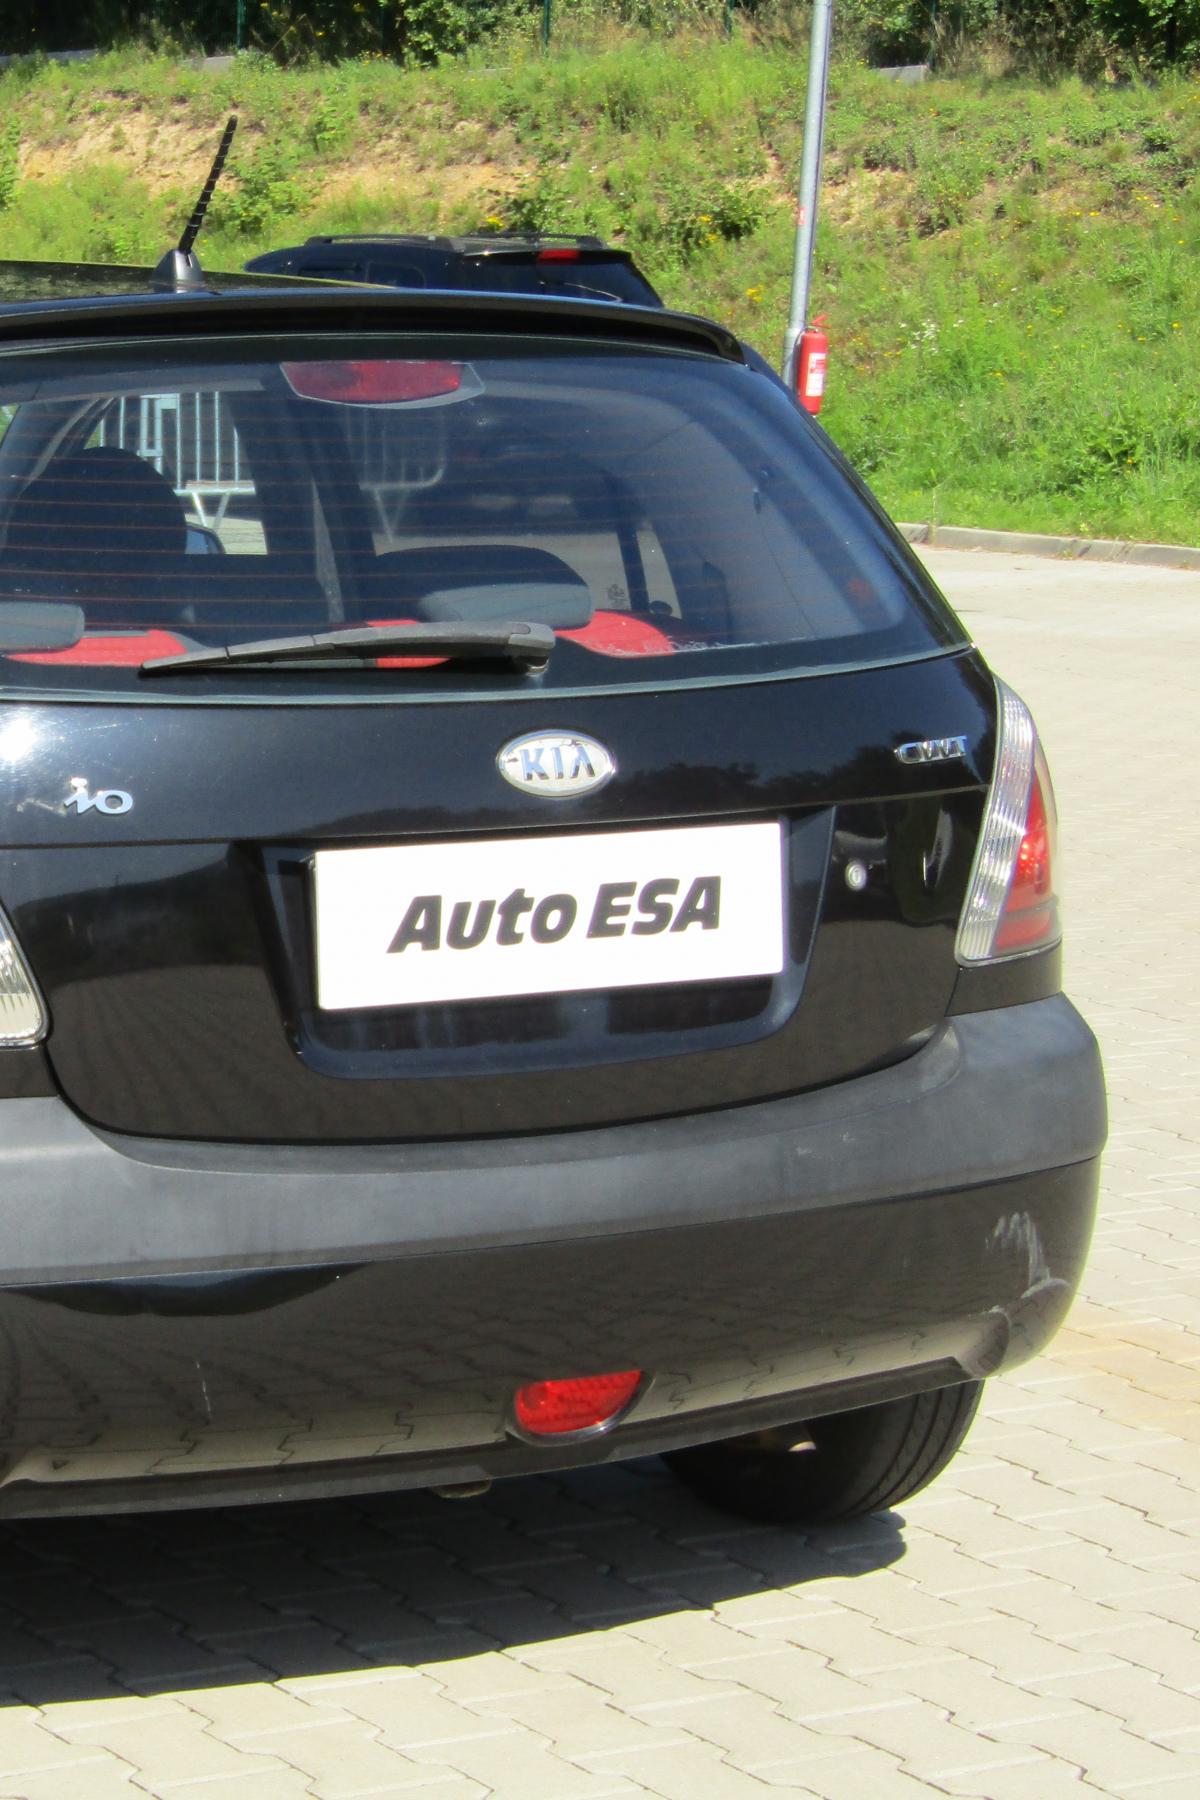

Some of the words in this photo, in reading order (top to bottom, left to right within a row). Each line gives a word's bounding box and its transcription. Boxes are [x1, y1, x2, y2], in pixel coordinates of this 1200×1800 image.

[520, 745, 596, 781] KIA
[386, 888, 578, 954] Auto
[586, 875, 722, 939] ESA
